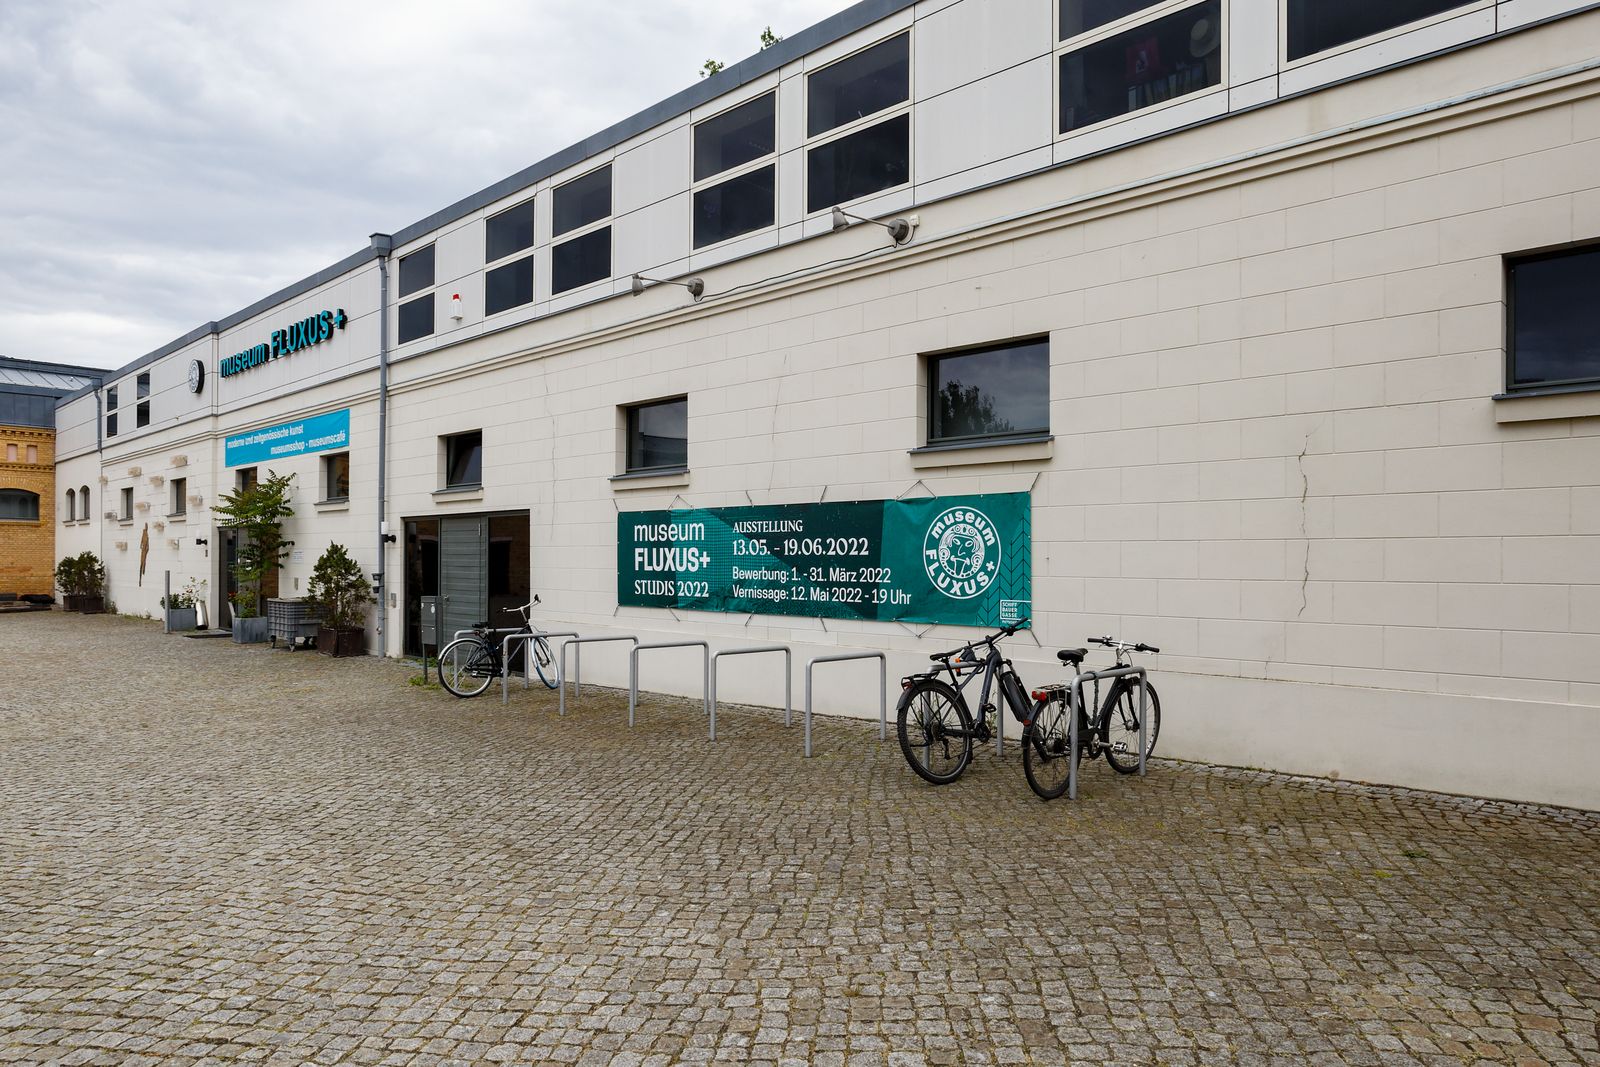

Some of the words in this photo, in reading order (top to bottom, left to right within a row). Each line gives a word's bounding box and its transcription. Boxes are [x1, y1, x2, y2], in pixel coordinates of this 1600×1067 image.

[219, 343, 270, 378] museum
[271, 308, 348, 359] FLUXUS+
[289, 423, 304, 436] kunst
[270, 440, 305, 455] museumsshop
[308, 429, 346, 448] museumscafé
[634, 522, 705, 542] museum
[732, 520, 804, 534] AUSSTELLUNG
[931, 510, 996, 547] museum
[732, 538, 771, 556] 13.05.
[783, 537, 869, 556] 19.06.2022
[634, 547, 711, 572] FLUXUS+
[732, 566, 790, 584] Bewerbung:
[791, 567, 801, 581] 1.
[809, 567, 827, 582] 31.
[829, 567, 857, 582] März
[859, 567, 891, 583] 2022
[634, 579, 675, 596] STUDIS
[677, 581, 710, 598] 2022
[732, 584, 790, 603] Vernissage:
[791, 585, 808, 601] 12.
[810, 586, 830, 602] Mai
[831, 587, 862, 603] 2022
[871, 588, 888, 604] 19
[890, 588, 912, 605] Uhr
